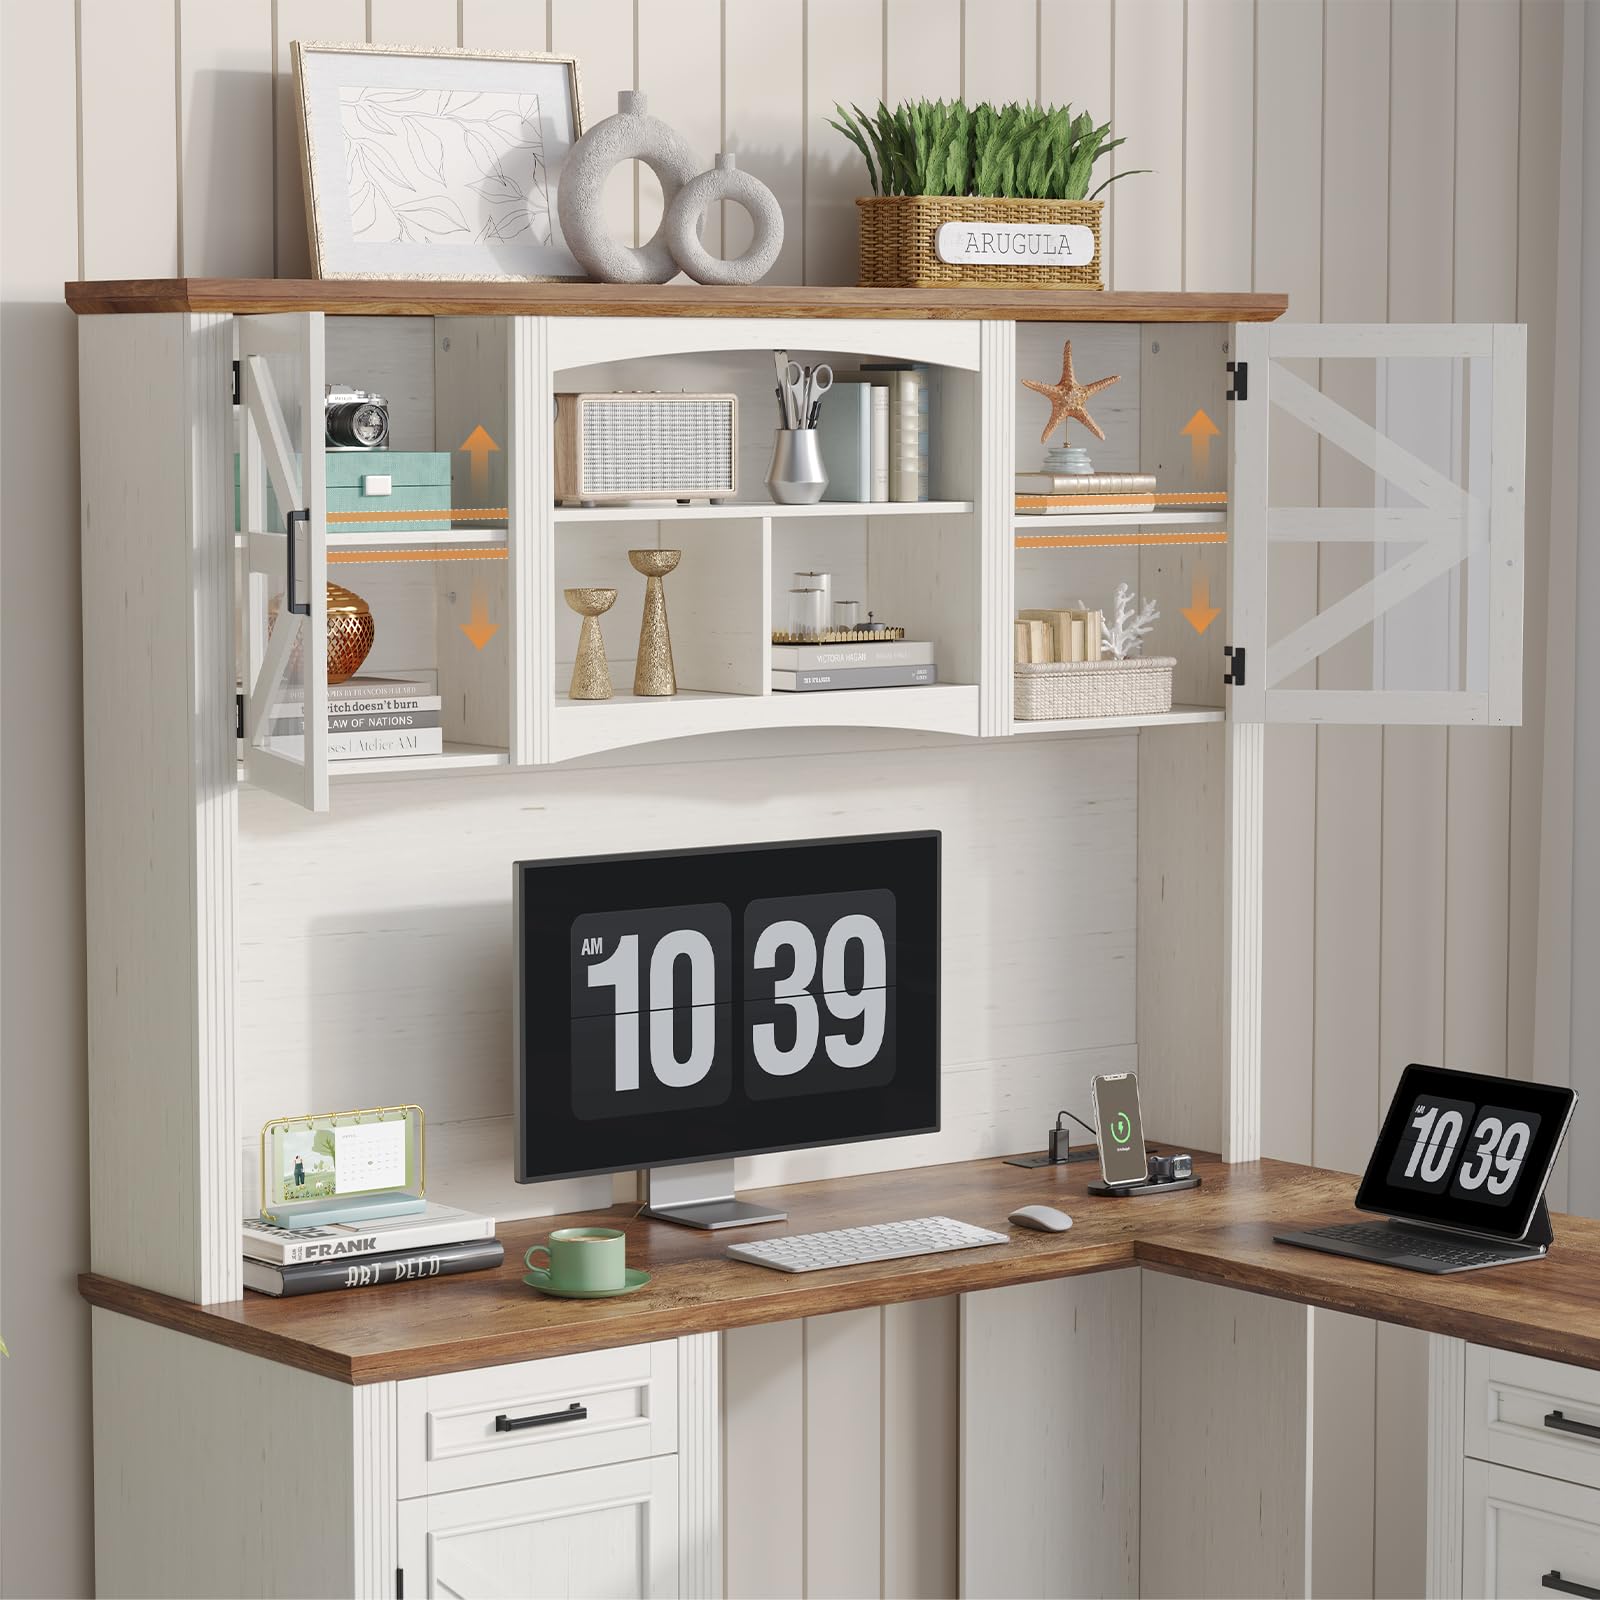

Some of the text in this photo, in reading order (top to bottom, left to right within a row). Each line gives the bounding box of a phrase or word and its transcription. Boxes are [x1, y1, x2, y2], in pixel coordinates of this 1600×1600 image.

[965, 232, 1072, 255] ARUGULA
[328, 699, 419, 713] itch doesn't burn
[328, 715, 413, 729] LAW OF NATIONS
[581, 937, 603, 956] AM
[587, 914, 887, 1092] 10 39
[1404, 1107, 1531, 1195] 10 39
[305, 1237, 377, 1259] FRANK
[345, 1255, 441, 1288] ART DECO
